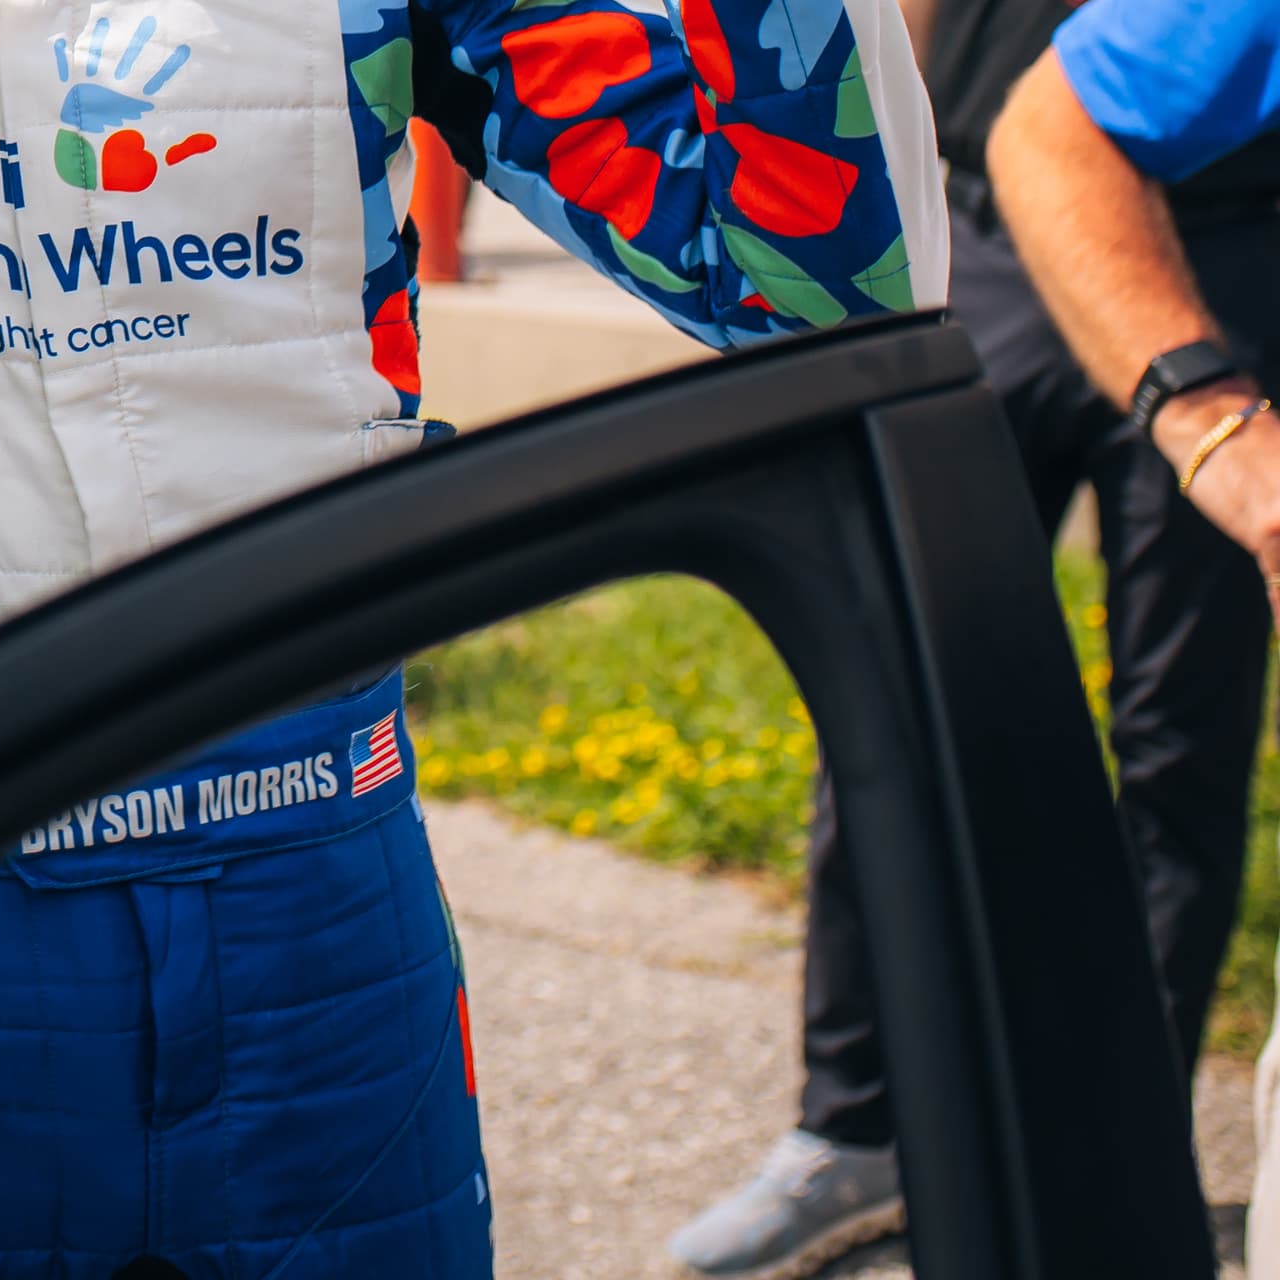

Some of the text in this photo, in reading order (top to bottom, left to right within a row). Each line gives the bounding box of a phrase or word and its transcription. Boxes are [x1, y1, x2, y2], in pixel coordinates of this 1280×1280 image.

[39, 215, 304, 294] Wheels
[67, 308, 190, 352] cancer
[197, 751, 339, 826] MORRIS
